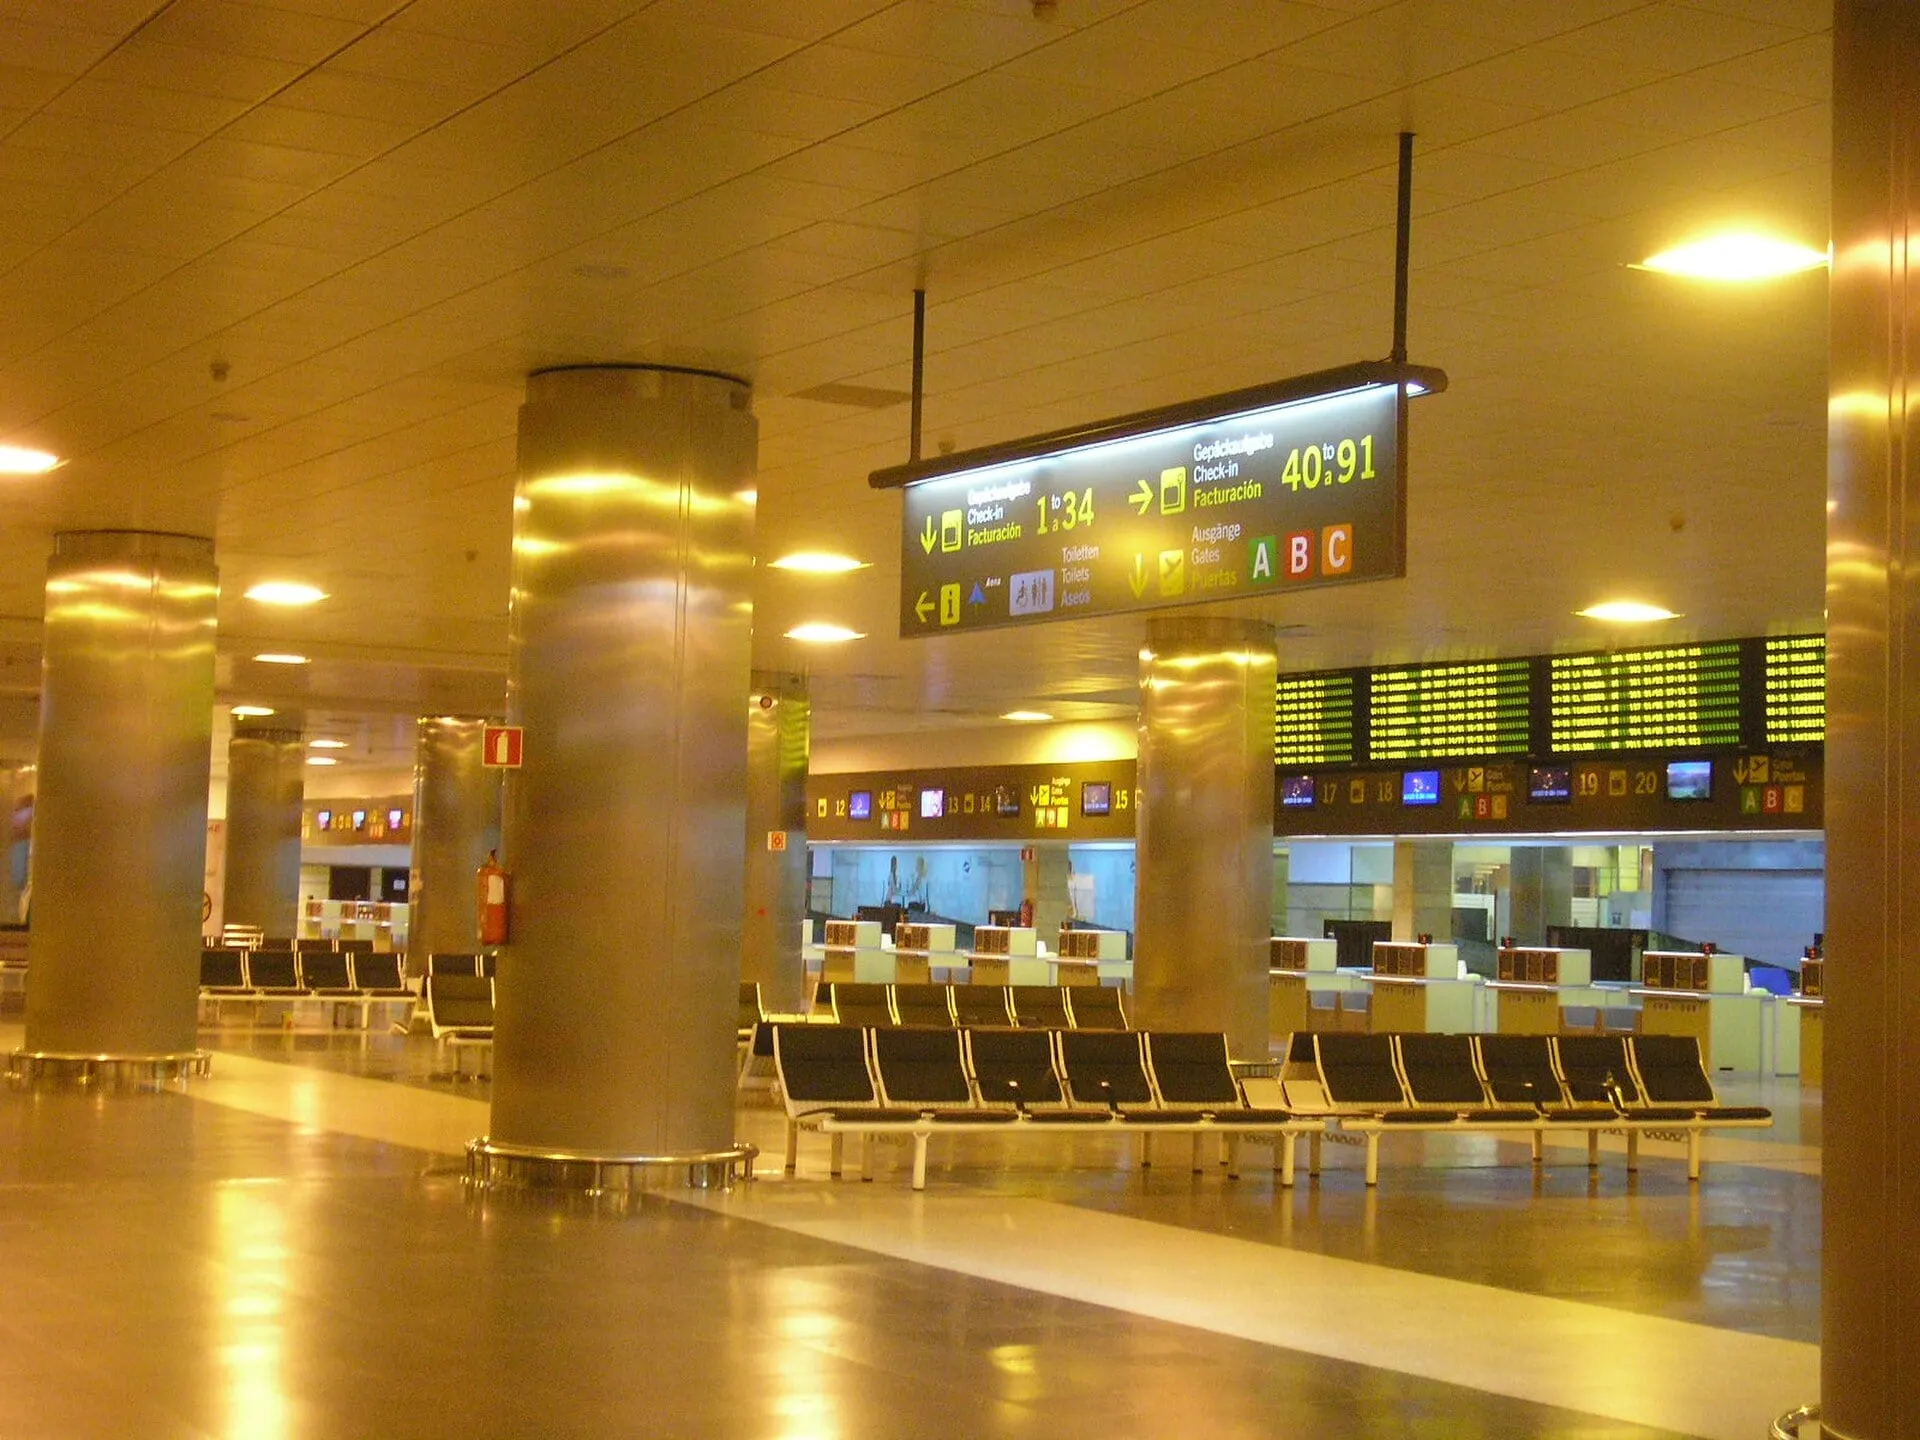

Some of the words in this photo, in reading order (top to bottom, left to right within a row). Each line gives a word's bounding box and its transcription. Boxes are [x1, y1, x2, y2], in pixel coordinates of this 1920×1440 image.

[1193, 460, 1239, 483] Check-in
[1281, 445, 1322, 492] 40
[1322, 443, 1335, 461] to
[1337, 434, 1375, 484] 91
[1324, 471, 1332, 486] a
[1194, 480, 1262, 507] Facturación
[967, 505, 1003, 525] Check-in
[1037, 496, 1048, 535] 1
[1051, 494, 1061, 510] to
[1063, 488, 1095, 530] 34
[968, 522, 1021, 546] Facturación
[1052, 519, 1059, 531] a
[1191, 523, 1241, 544] Ausgänge
[1062, 545, 1099, 564] Toiletten
[1191, 548, 1220, 566] Gates
[1253, 543, 1270, 579] A
[1291, 536, 1308, 574] B
[1329, 530, 1346, 568] C
[1062, 567, 1090, 584] Toilets
[1192, 569, 1238, 589] Puertas
[1061, 590, 1091, 607] Aseos
[1323, 782, 1337, 804] 17
[1378, 781, 1392, 803] 18
[1579, 773, 1598, 796] 19
[1635, 772, 1657, 794] 20
[836, 799, 845, 816] 12
[948, 796, 958, 813] 13
[1115, 790, 1128, 809] 15
[1461, 801, 1470, 813] A
[1478, 799, 1487, 815] B
[1745, 790, 1755, 809] A
[1767, 790, 1777, 808] B
